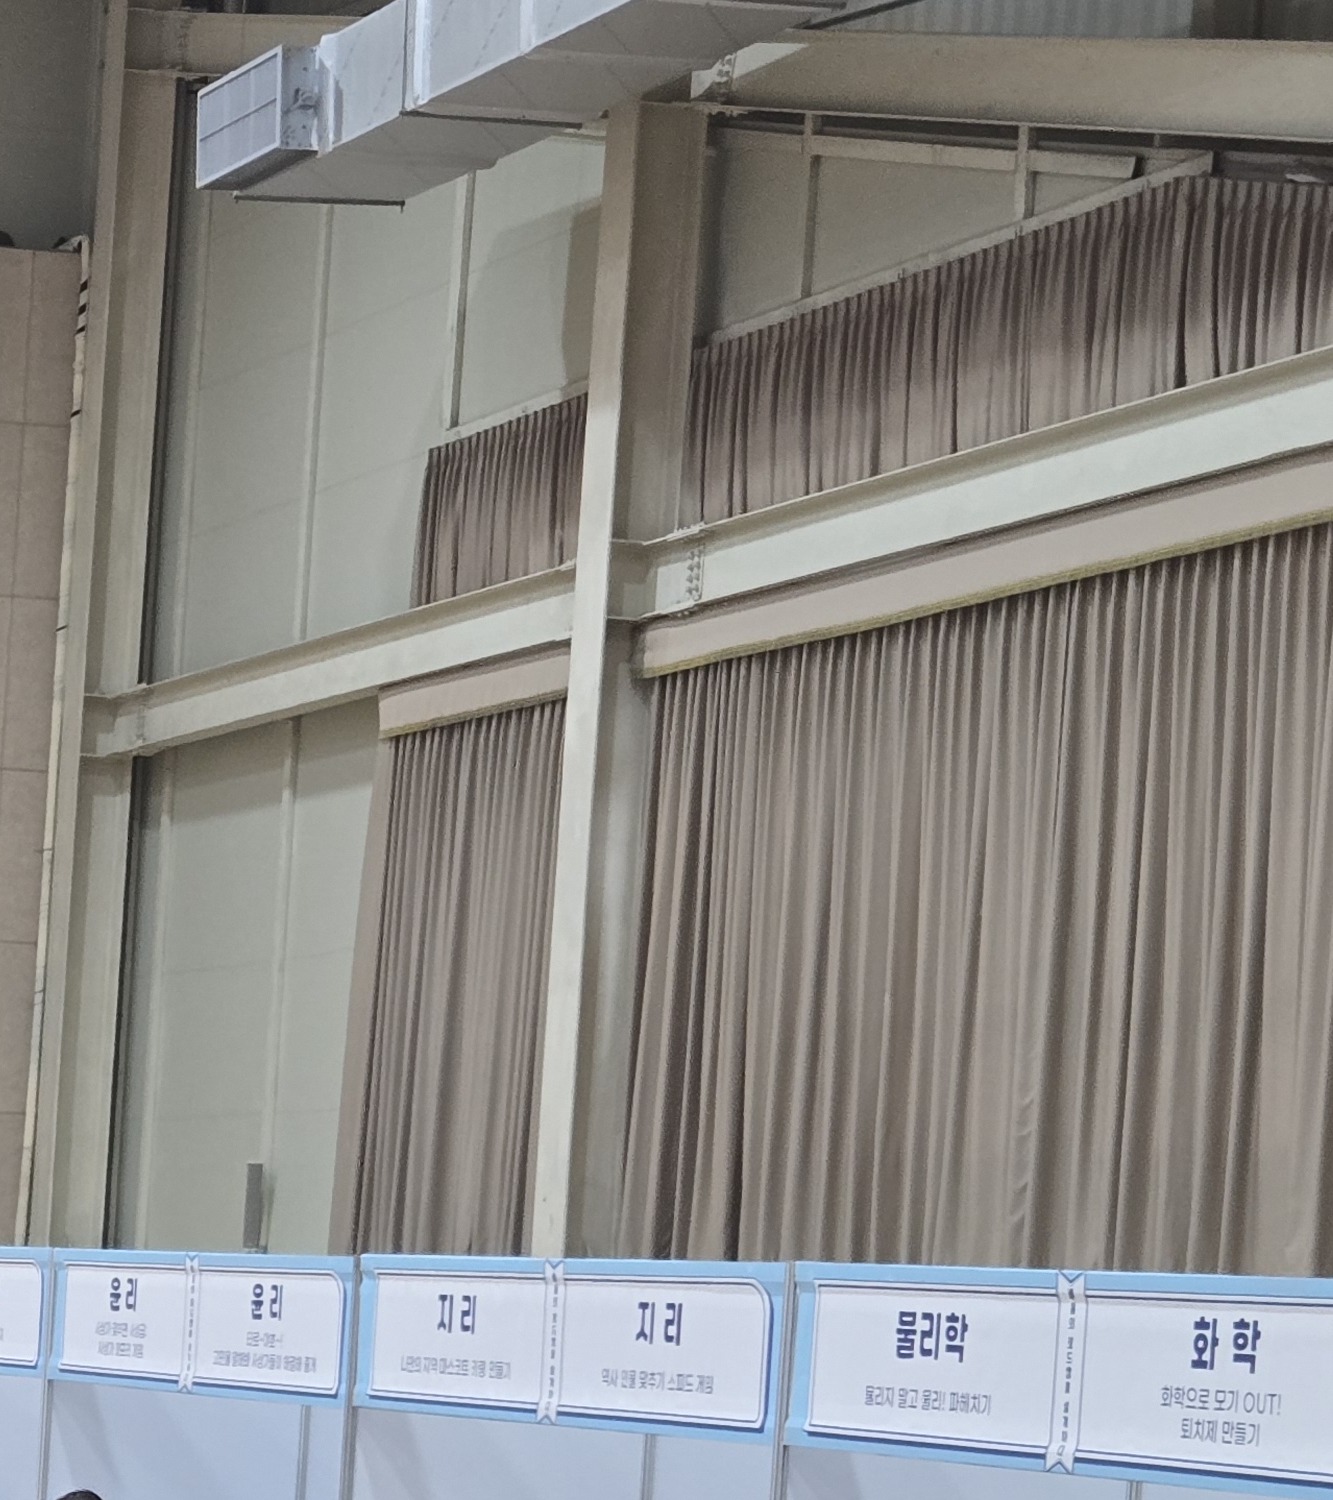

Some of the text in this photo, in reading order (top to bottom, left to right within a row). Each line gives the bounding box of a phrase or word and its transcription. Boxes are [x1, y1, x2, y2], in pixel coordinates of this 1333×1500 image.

[436, 1294, 477, 1335] 지리
[635, 1301, 683, 1346] 지리
[895, 1310, 968, 1364] 물리학
[949, 1391, 992, 1416] 파헤치기
[1160, 1384, 1282, 1416] 화학으로 모기 OUT!
[1180, 1417, 1261, 1448] 퇴치제 만들기
